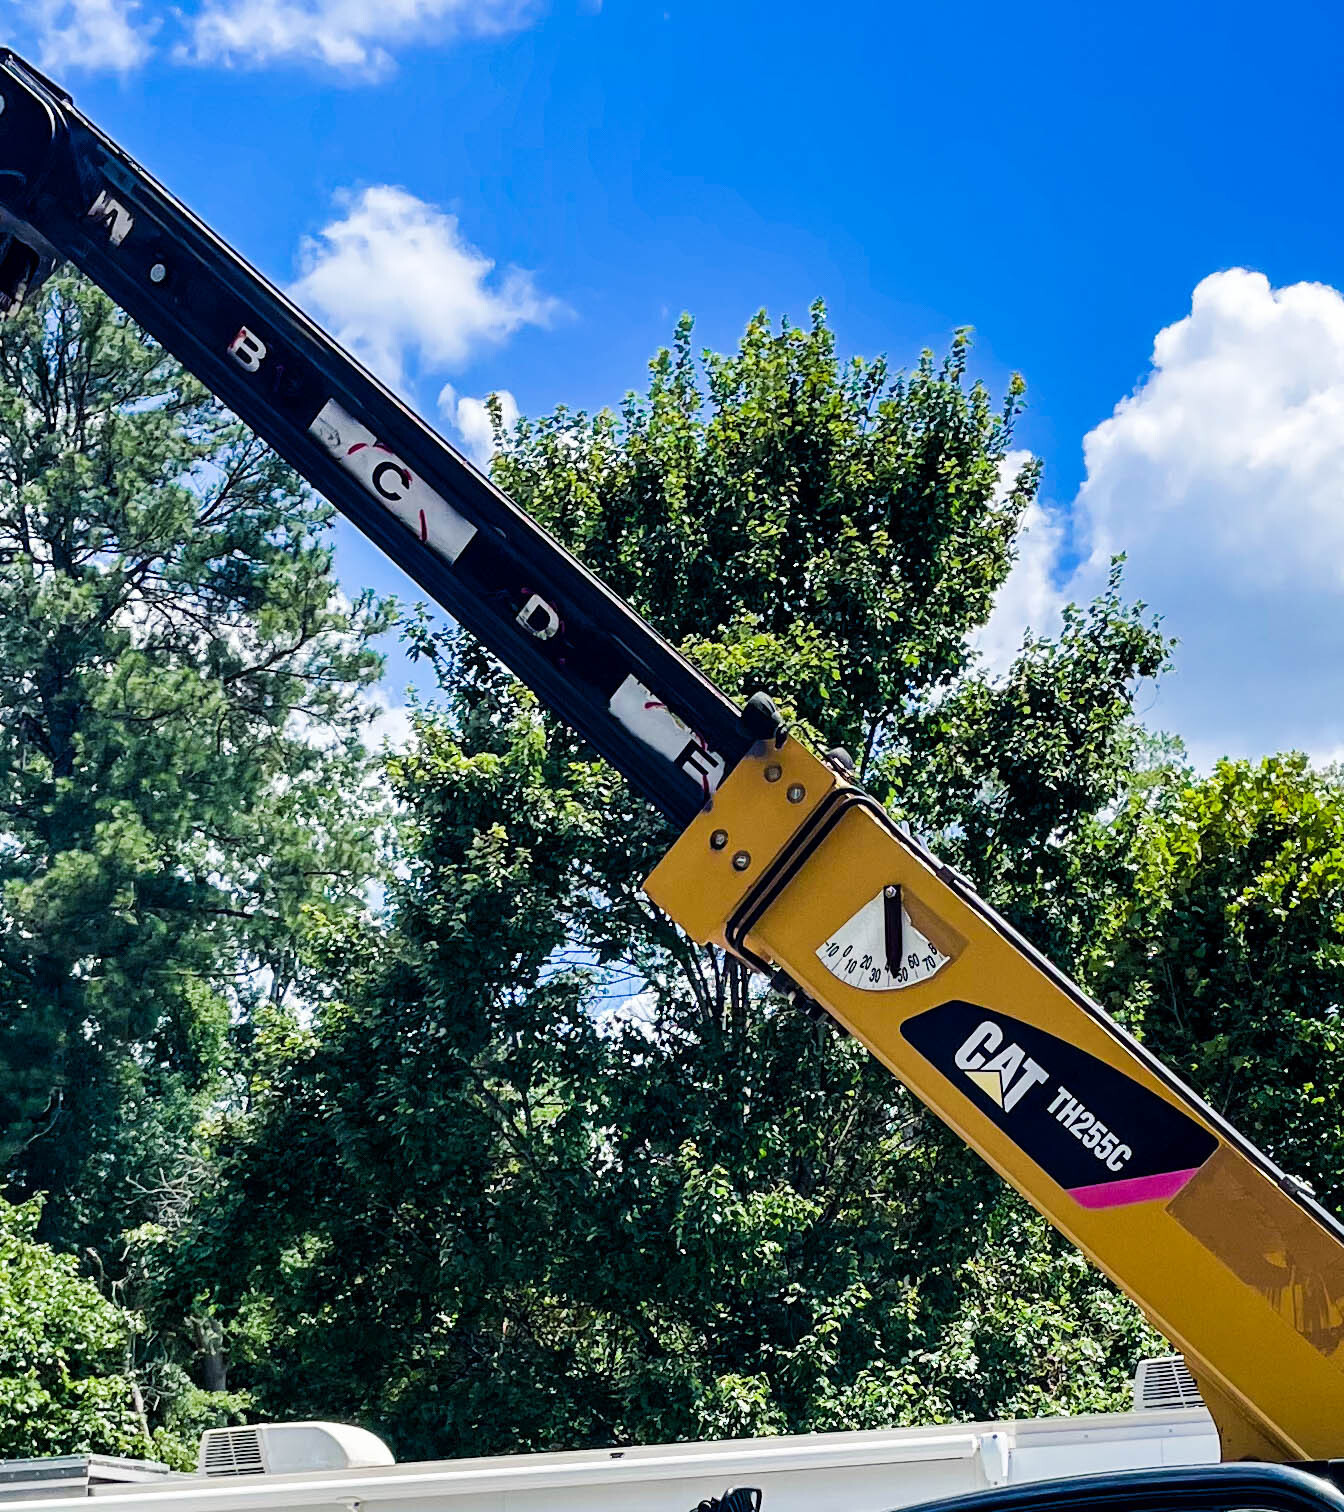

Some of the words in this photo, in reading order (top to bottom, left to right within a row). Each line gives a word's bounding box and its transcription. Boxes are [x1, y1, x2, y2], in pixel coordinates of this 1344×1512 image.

[227, 326, 267, 372] B
[372, 461, 410, 501] C
[515, 594, 560, 641] D
[842, 945, 853, 957] 0
[844, 958, 858, 974] 10
[859, 954, 873, 970] 20
[908, 953, 920, 969] 60
[922, 955, 936, 971] 70
[869, 967, 881, 983] 30
[955, 1021, 1050, 1113] CAT
[1046, 1085, 1133, 1172] TH255C
